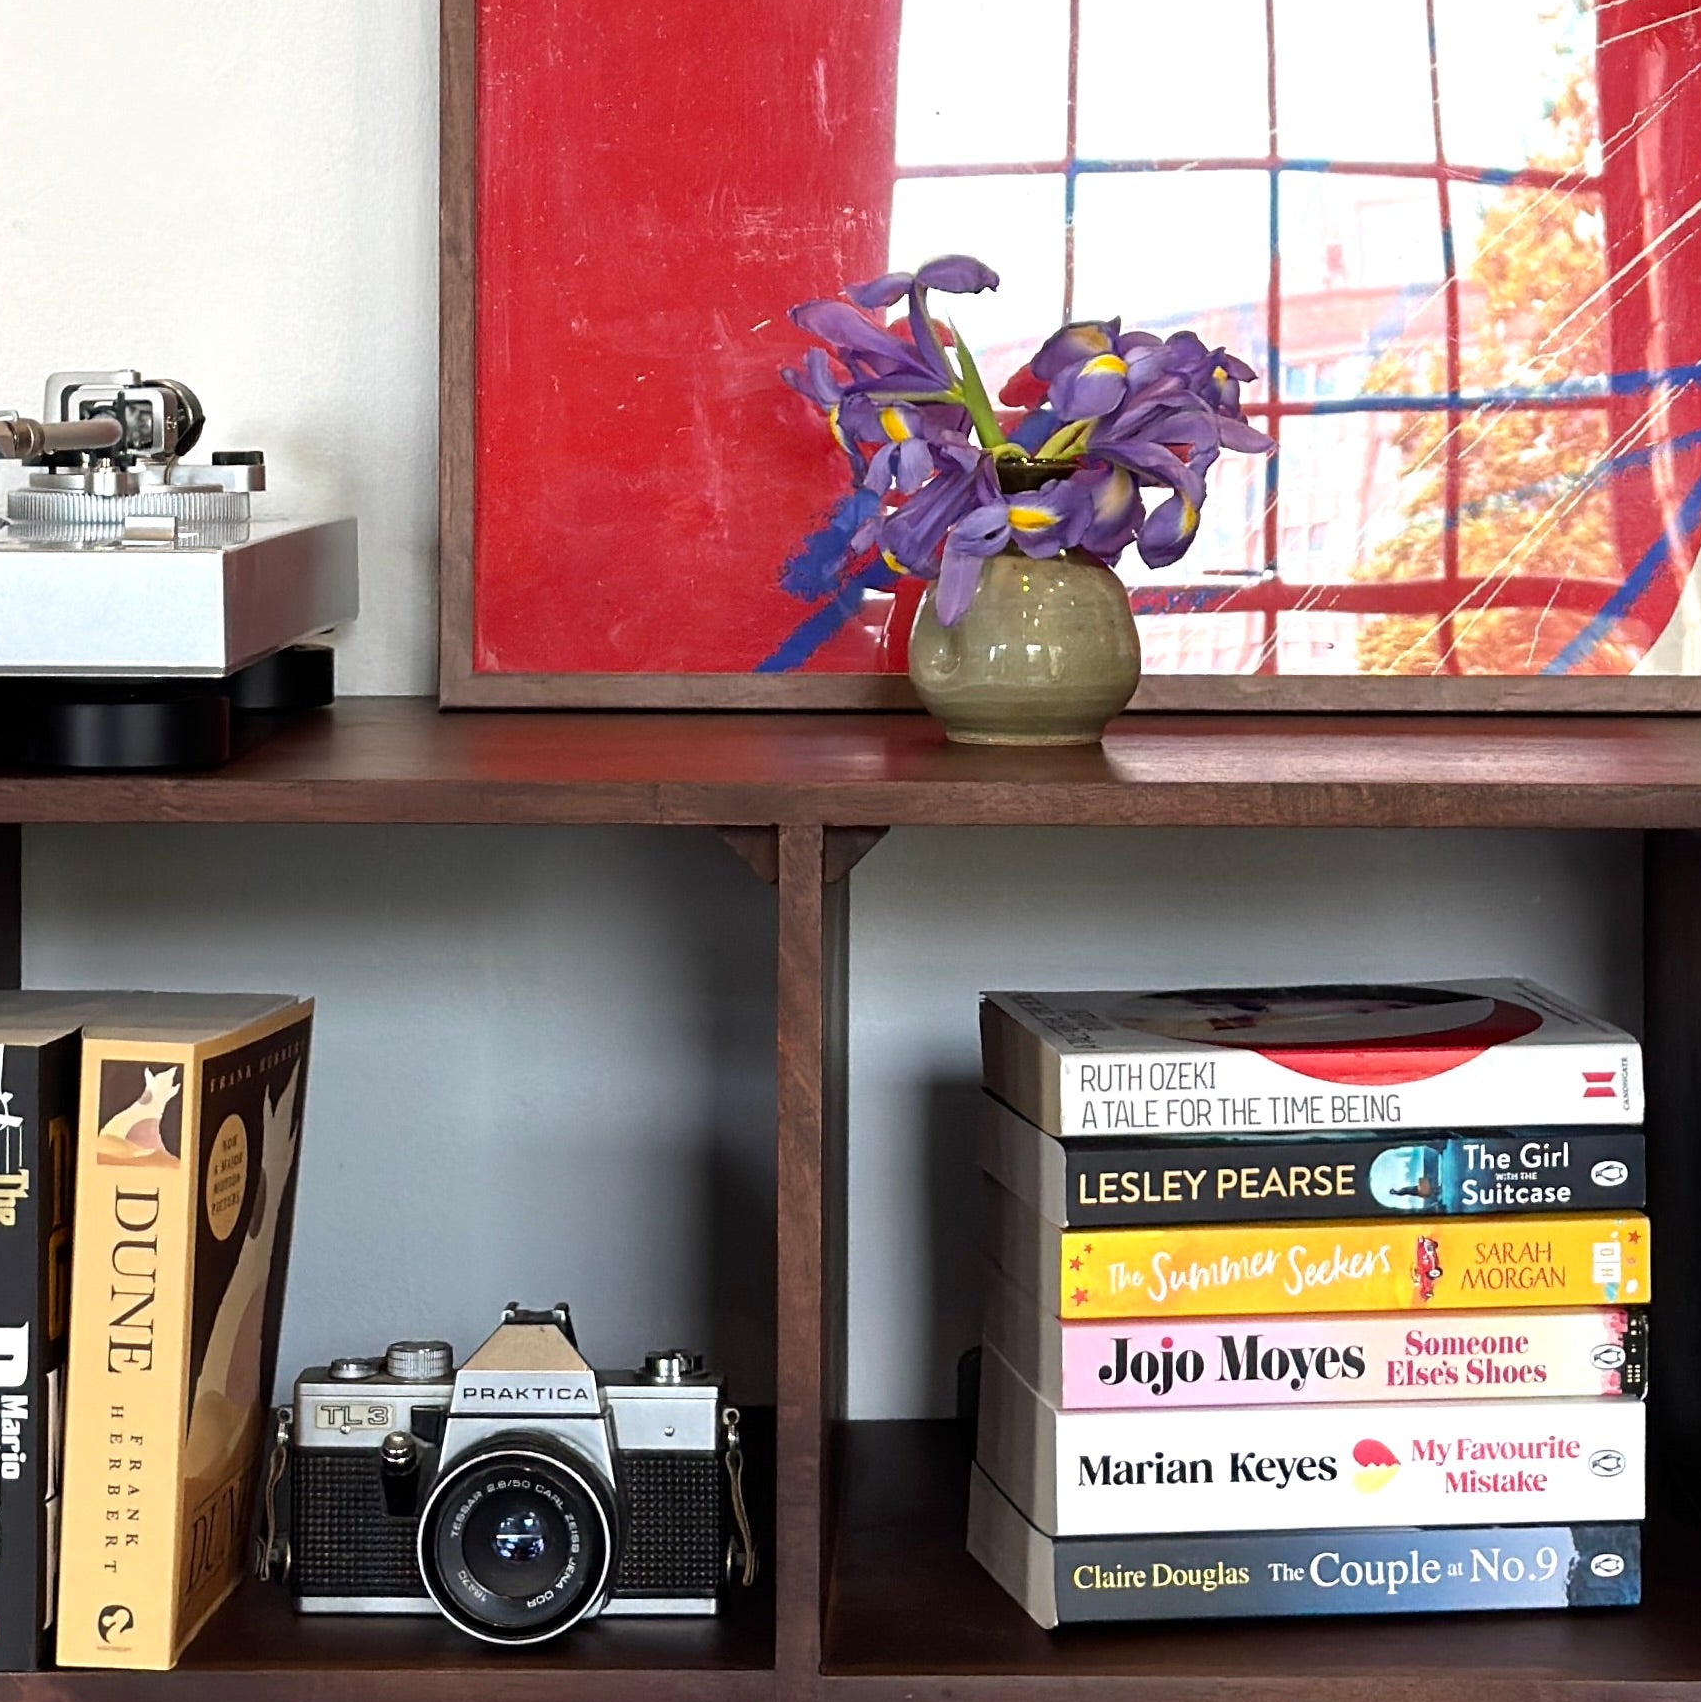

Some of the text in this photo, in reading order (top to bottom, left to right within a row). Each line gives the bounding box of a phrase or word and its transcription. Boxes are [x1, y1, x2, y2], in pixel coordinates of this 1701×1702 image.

[1081, 1062, 1216, 1093] RUTH OZEKI
[1082, 1094, 1401, 1128] A TALE FOR THE TIME BEING
[1463, 1142, 1569, 1169] The Girl
[1079, 1165, 1355, 1204] LESLEY PEARSE
[1520, 1172, 1537, 1180] THE
[1462, 1180, 1571, 1204] Suitcase
[1476, 1241, 1551, 1264] SARAH
[108, 1184, 160, 1374] DUNE
[1109, 1244, 1390, 1300] The Summer Seekers
[1461, 1267, 1565, 1290] MORGAN
[1404, 1329, 1529, 1356] Someone
[1099, 1334, 1366, 1396] Jojo Moyes
[1386, 1358, 1547, 1386] Else's Shoes
[463, 1386, 589, 1401] PRAKTICA
[0, 1394, 29, 1480] Mario
[1411, 1436, 1580, 1466] My Favourite
[1078, 1450, 1338, 1485] Marian Keyes
[1445, 1469, 1548, 1493] Mistake
[104, 1405, 124, 1573] HERBERT
[126, 1435, 143, 1547] FRANK
[535, 1484, 564, 1510] CARL
[556, 1557, 576, 1589] JENA
[1074, 1562, 1250, 1590] Claire Douglas
[1268, 1547, 1558, 1591] The Couple at No.9
